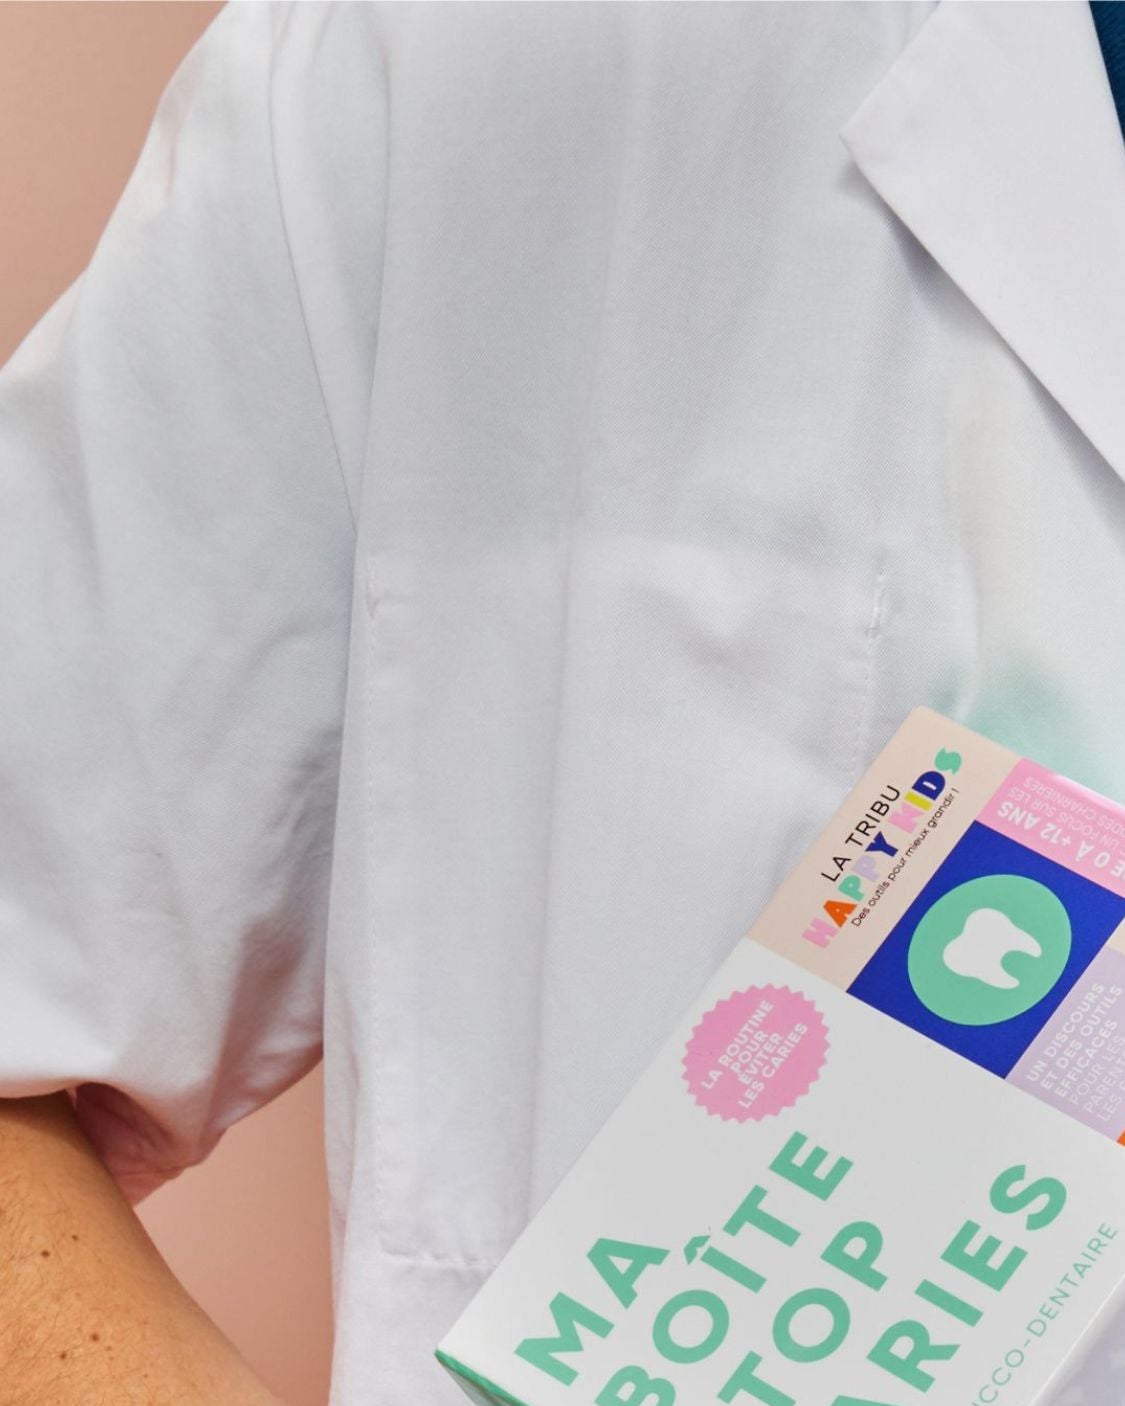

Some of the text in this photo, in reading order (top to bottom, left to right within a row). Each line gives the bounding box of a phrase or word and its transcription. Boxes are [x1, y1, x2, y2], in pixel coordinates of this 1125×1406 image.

[998, 802, 1040, 829] ANS
[1008, 787, 1031, 805] LES
[1031, 799, 1057, 817] SUR
[1058, 812, 1100, 840] FOCUS
[802, 748, 961, 948] HAPPY KIDS
[821, 785, 900, 882] LA TRIBU
[851, 793, 955, 927] Des outils pour mieux grandir
[1040, 823, 1072, 847] +12
[1095, 852, 1110, 869] 0
[1101, 835, 1119, 851] UN
[701, 1000, 774, 1090] LA ROUTINE
[730, 1030, 768, 1073] POUR
[738, 1023, 808, 1109] LES CARIES
[1026, 983, 1104, 1081] UN DISCOURS
[1041, 985, 1123, 1090] ET DES OUTILS
[1055, 1019, 1118, 1097] EFFICACES
[1070, 1035, 1125, 1105] POUR LES
[1098, 1094, 1123, 1121] LES
[514, 1236, 671, 1386] MA
